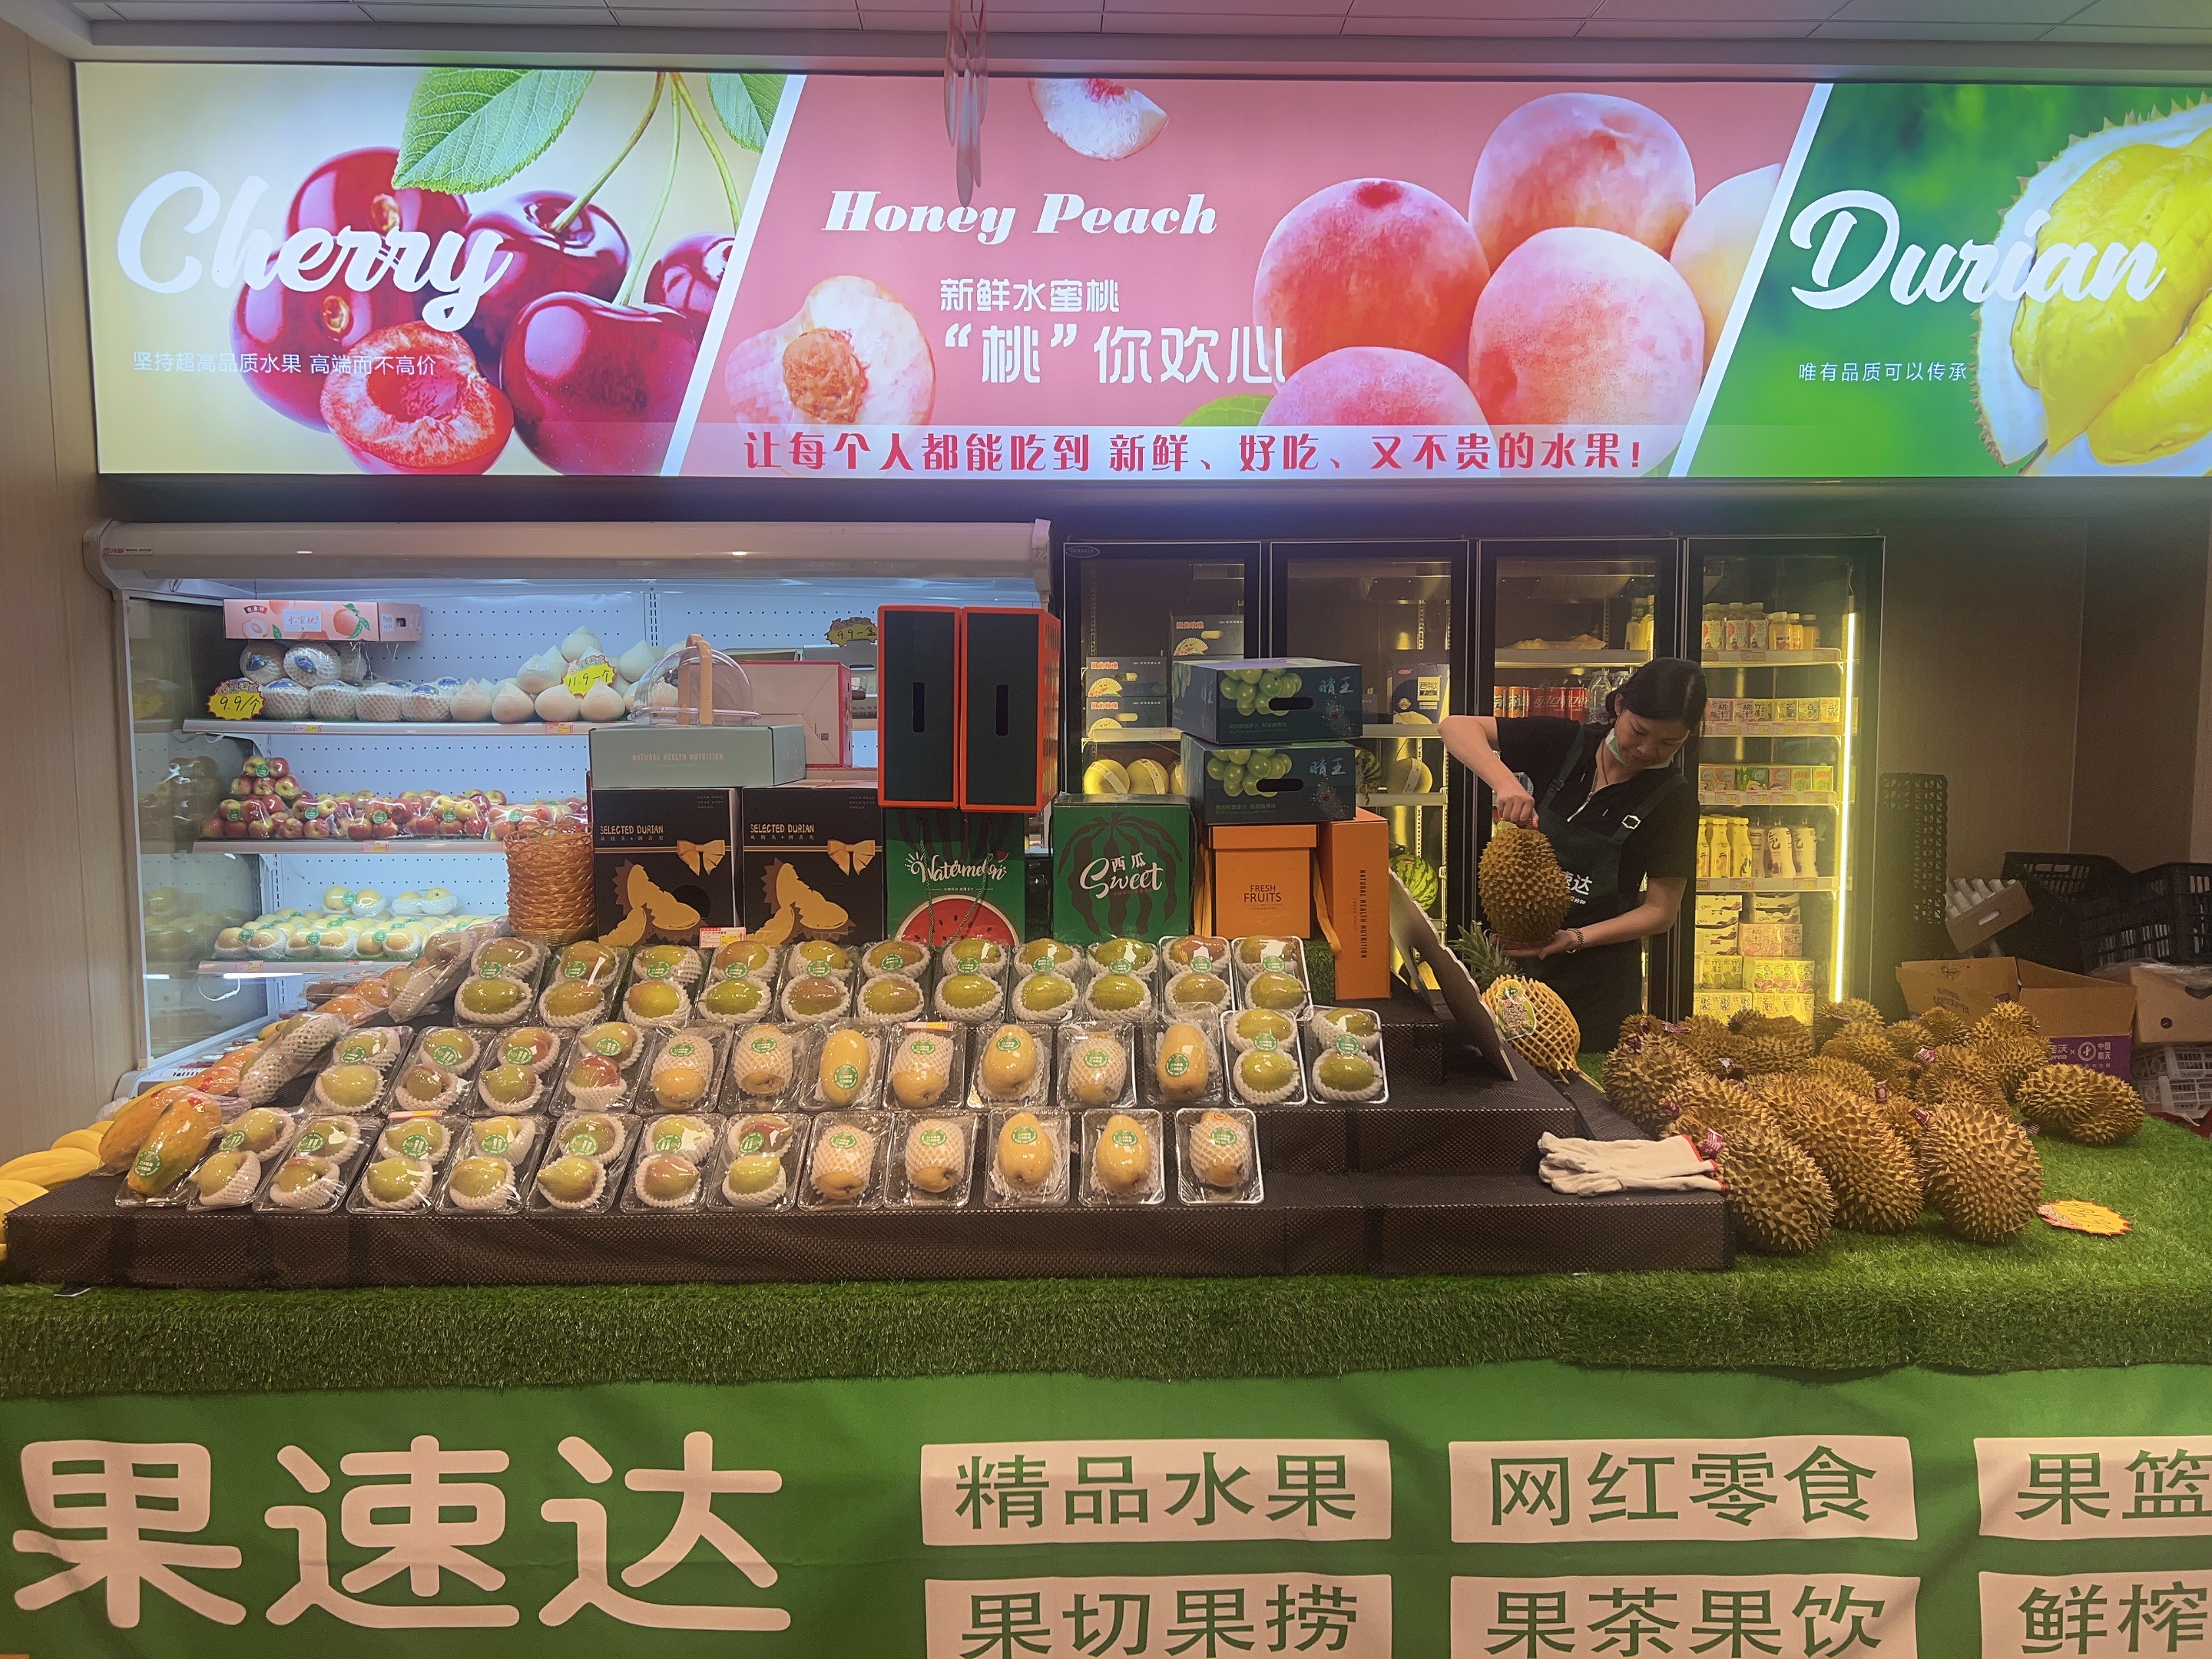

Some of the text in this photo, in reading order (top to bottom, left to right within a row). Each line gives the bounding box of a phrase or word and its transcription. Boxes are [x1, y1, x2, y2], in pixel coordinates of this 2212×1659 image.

[822, 190, 1217, 245] Honey Peach
[117, 171, 515, 332] Cherry
[1790, 188, 2166, 310] Durian
[939, 277, 1120, 313] 新鲜水蜜桃
[133, 352, 436, 377] 坚持超高品质水果 高端而不高价
[1798, 361, 1967, 383] 唯有品质可以传承
[744, 431, 1091, 473] 让每个人都能吃到
[220, 694, 260, 715] 9.9/个
[601, 825, 664, 835] SELECTED DURIAN
[750, 824, 814, 833] SELECTED DURIAN
[910, 853, 1005, 882] Watermelon
[1080, 857, 1164, 899] Sweet
[1111, 852, 1146, 873] 西瓜
[1244, 892, 1282, 902] FRUITS
[955, 1451, 1356, 1531] 精品水果
[1488, 1444, 1877, 1527] 网红零食
[2017, 1448, 2212, 1525] 果篮
[14, 1431, 791, 1632] 果速达
[961, 1584, 1358, 1659] 果切果捞
[1485, 1584, 1886, 1659] 果茶果饮
[2018, 1579, 2210, 1656] 鲜榨
